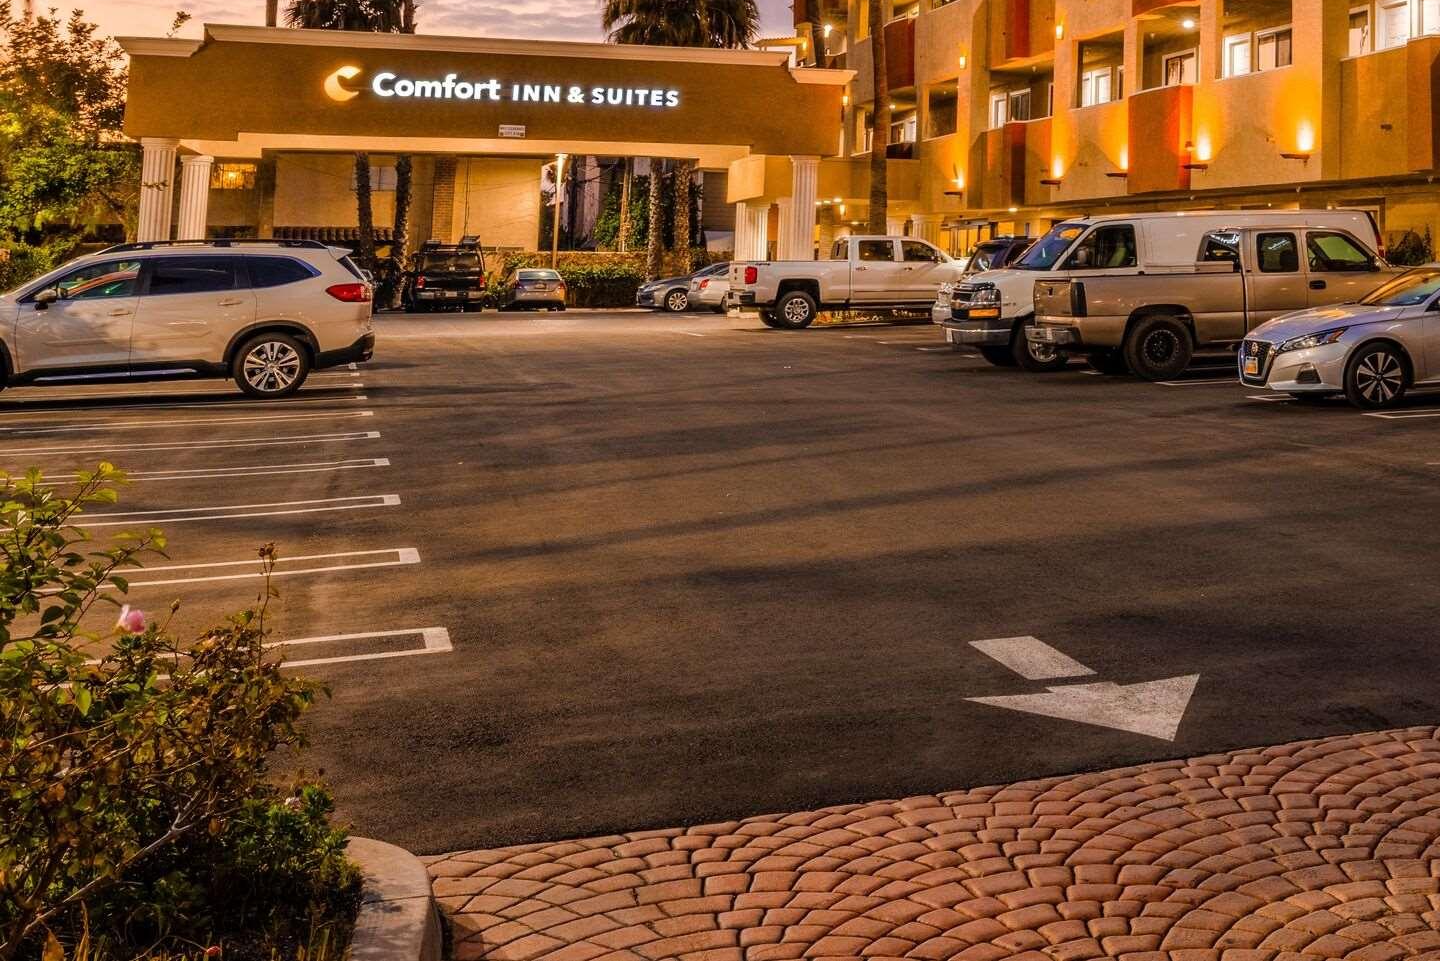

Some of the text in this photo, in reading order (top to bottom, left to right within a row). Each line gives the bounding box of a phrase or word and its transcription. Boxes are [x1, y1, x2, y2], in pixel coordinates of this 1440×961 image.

[372, 73, 679, 107] Comfort INN & SUITES
